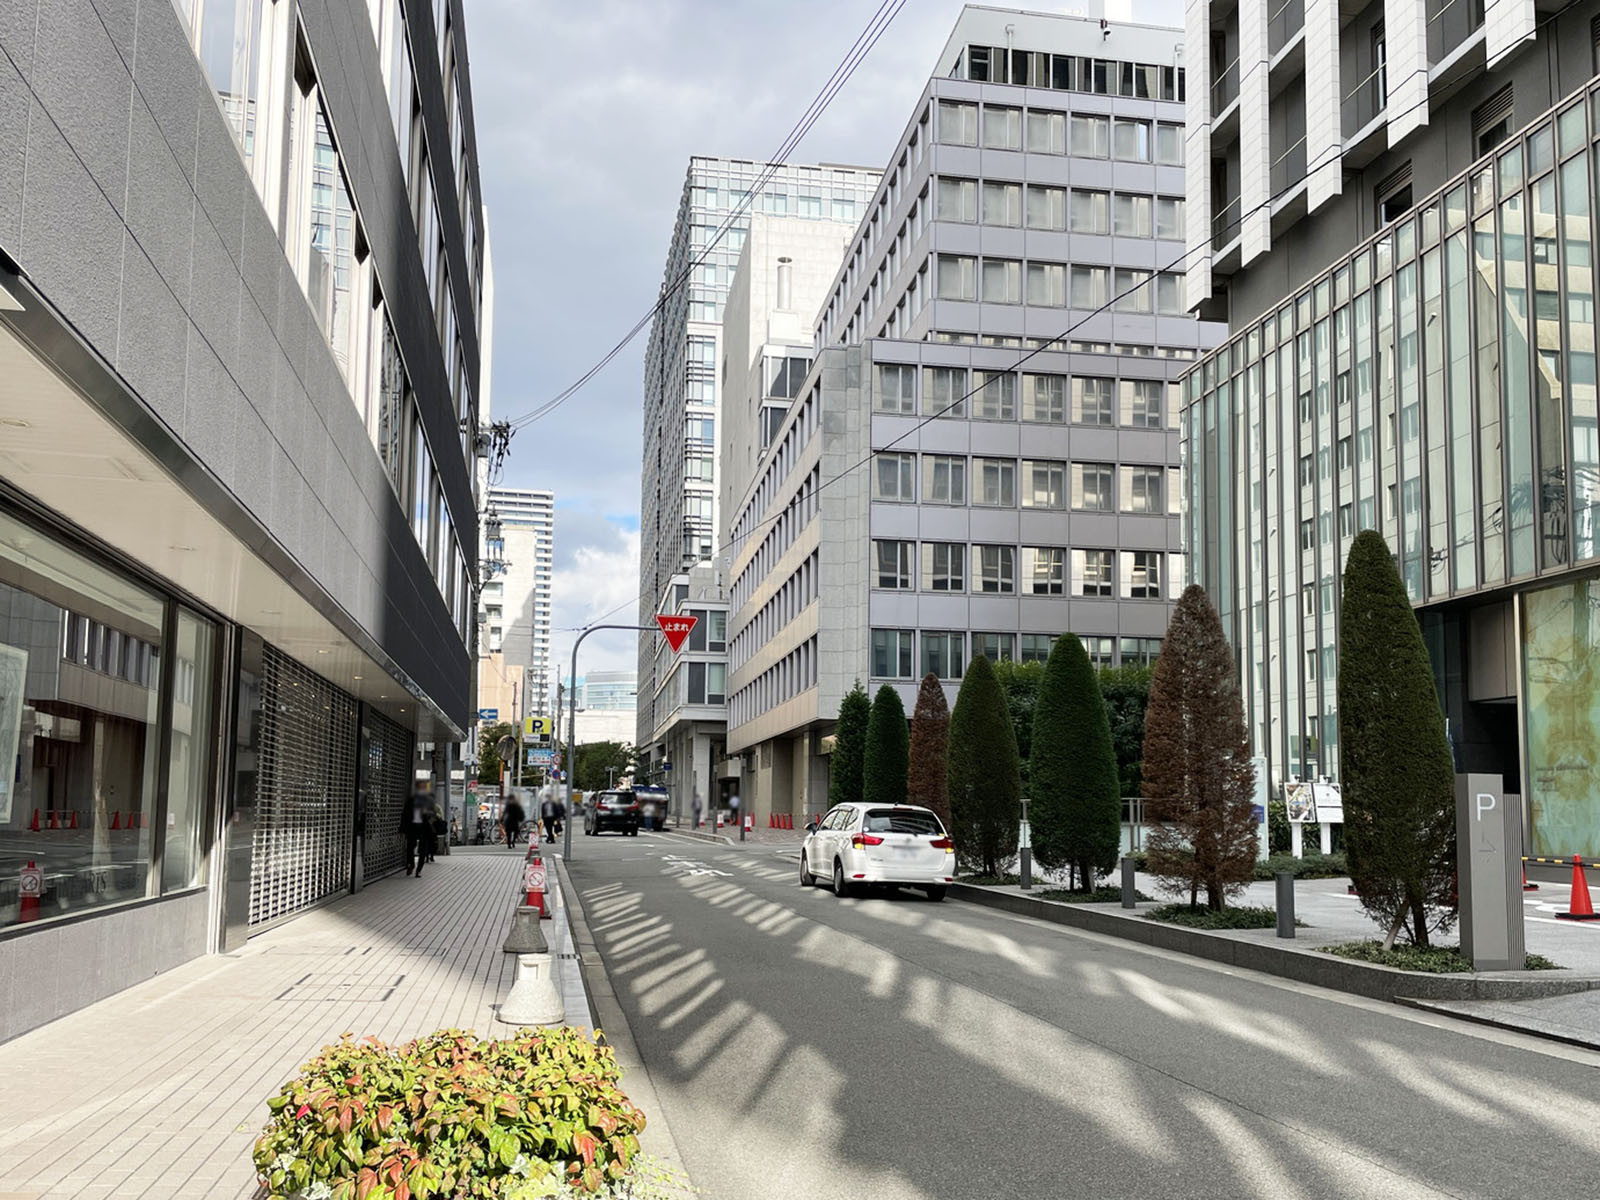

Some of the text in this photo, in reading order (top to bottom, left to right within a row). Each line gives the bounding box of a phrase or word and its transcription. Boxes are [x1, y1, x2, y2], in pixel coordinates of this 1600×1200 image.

[664, 622, 689, 632] 止まれ
[532, 720, 543, 733] P
[1476, 793, 1496, 821] P
